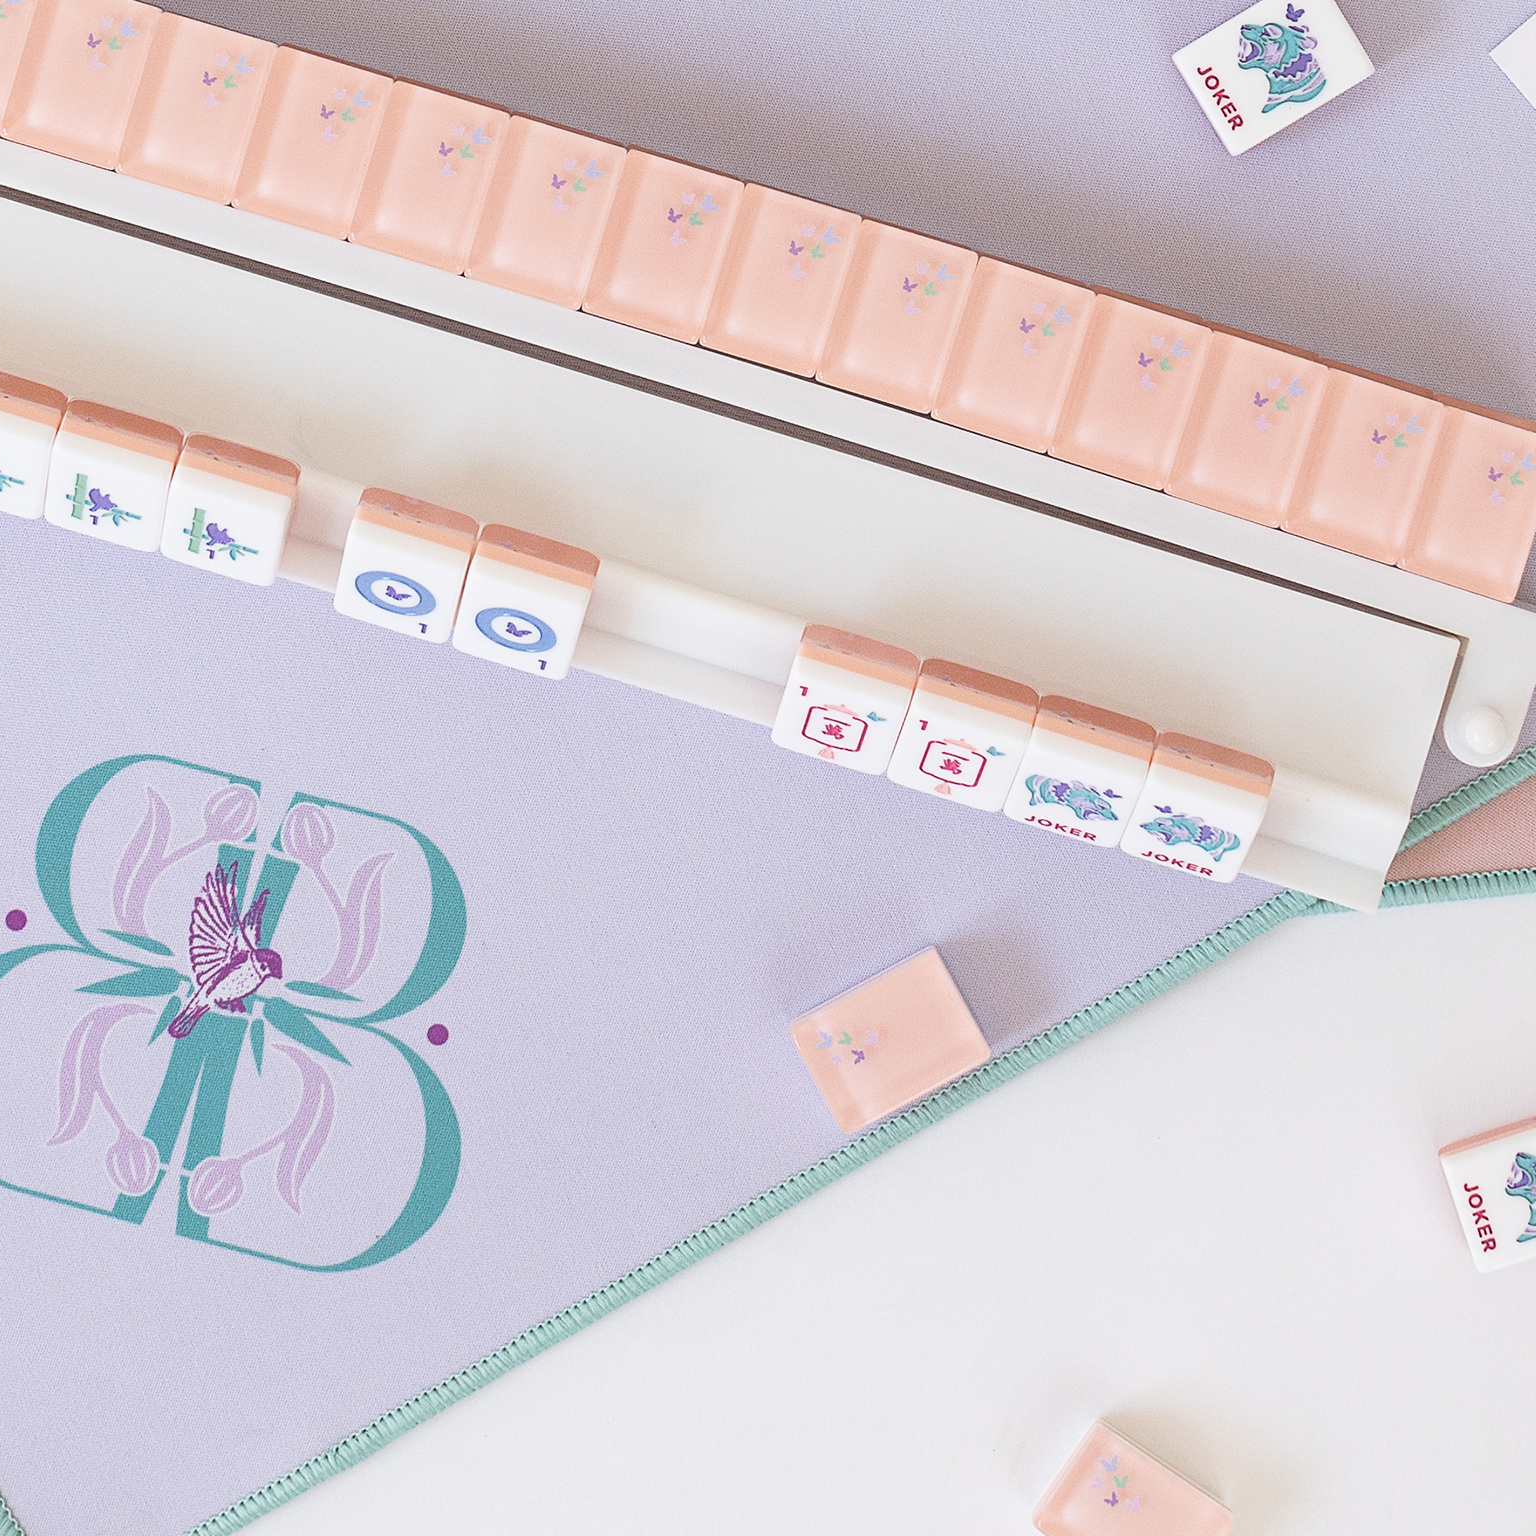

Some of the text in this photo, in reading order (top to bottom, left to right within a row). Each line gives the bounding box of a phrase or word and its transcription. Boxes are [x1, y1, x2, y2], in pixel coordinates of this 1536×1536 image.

[1196, 66, 1245, 132] JOKER
[89, 514, 99, 527] 1
[206, 548, 216, 560] 1
[418, 622, 428, 634] 1
[537, 659, 548, 671] 1
[799, 685, 809, 697] 1
[919, 719, 929, 731] 1
[1024, 813, 1097, 842] JOKER
[1141, 848, 1216, 877] JOKER
[1463, 1182, 1497, 1253] JOKER
